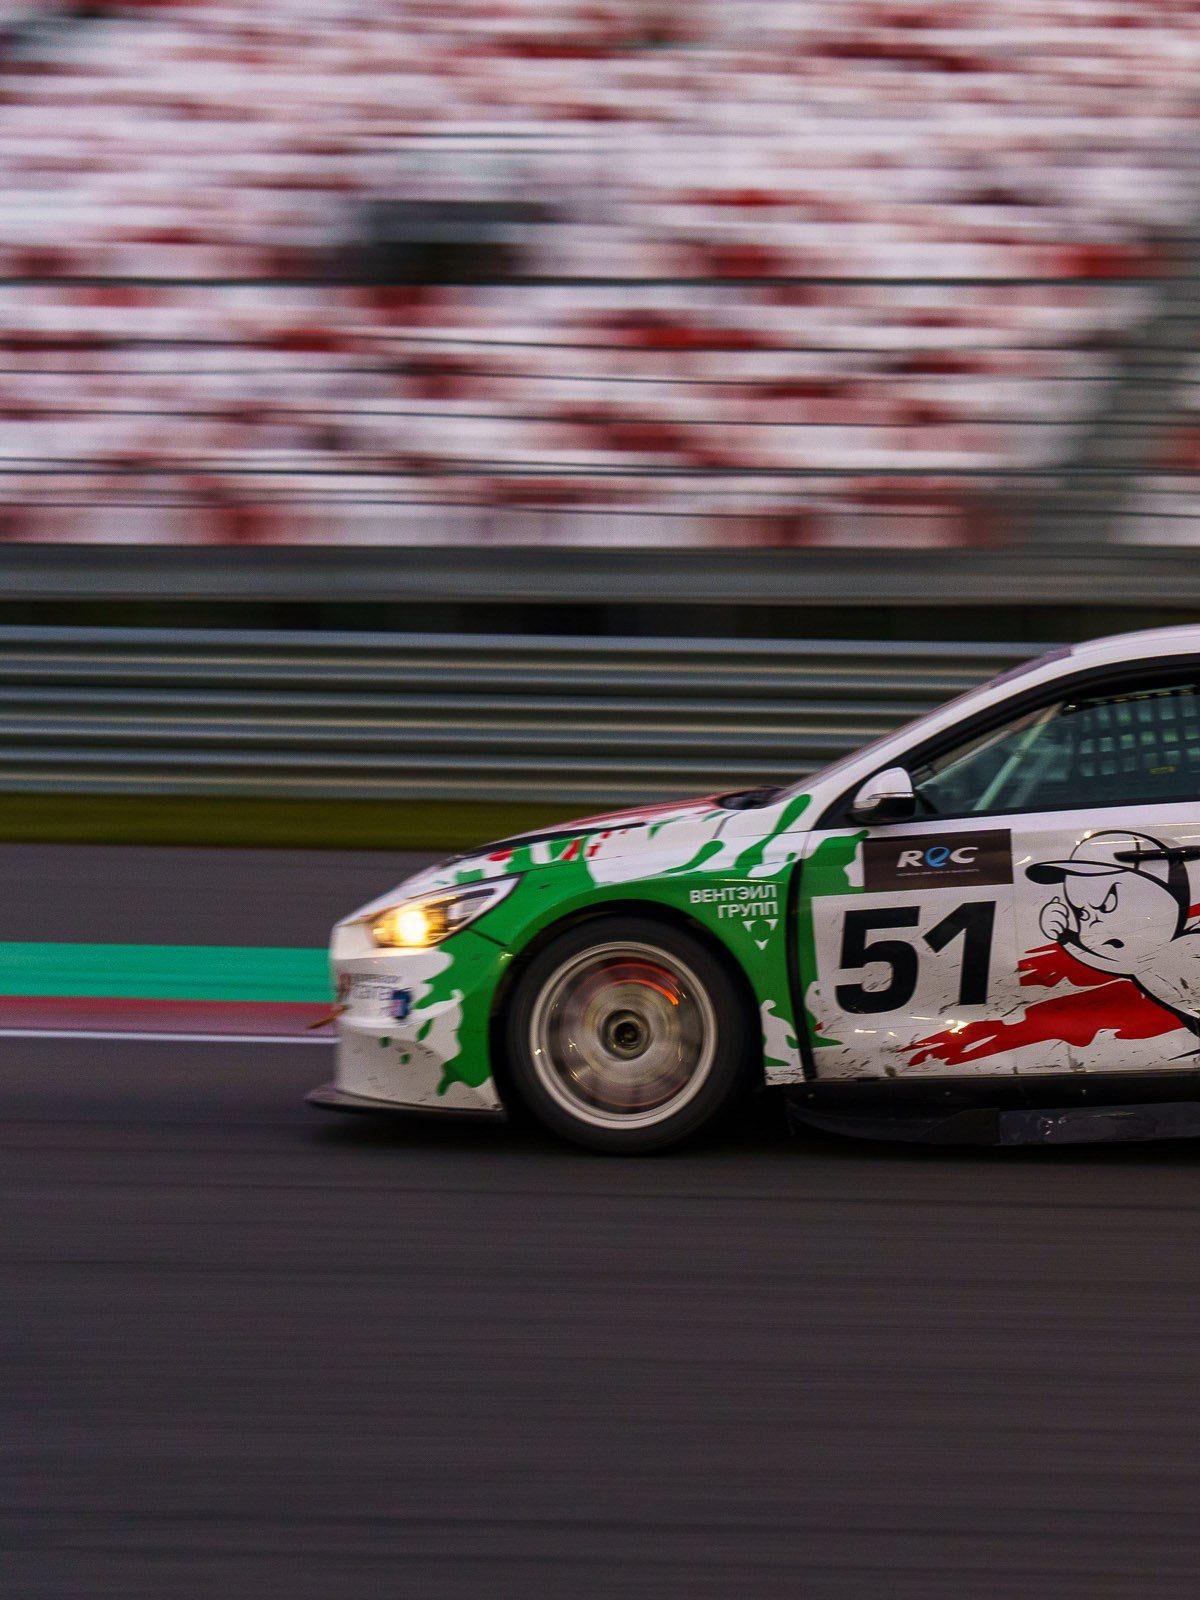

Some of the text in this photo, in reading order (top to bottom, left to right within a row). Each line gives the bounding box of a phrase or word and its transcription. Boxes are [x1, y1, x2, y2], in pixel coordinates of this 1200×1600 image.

[689, 884, 778, 904] ВЕНТЭИЛ
[717, 901, 779, 919] ГРУПП
[835, 900, 997, 1014] 51
